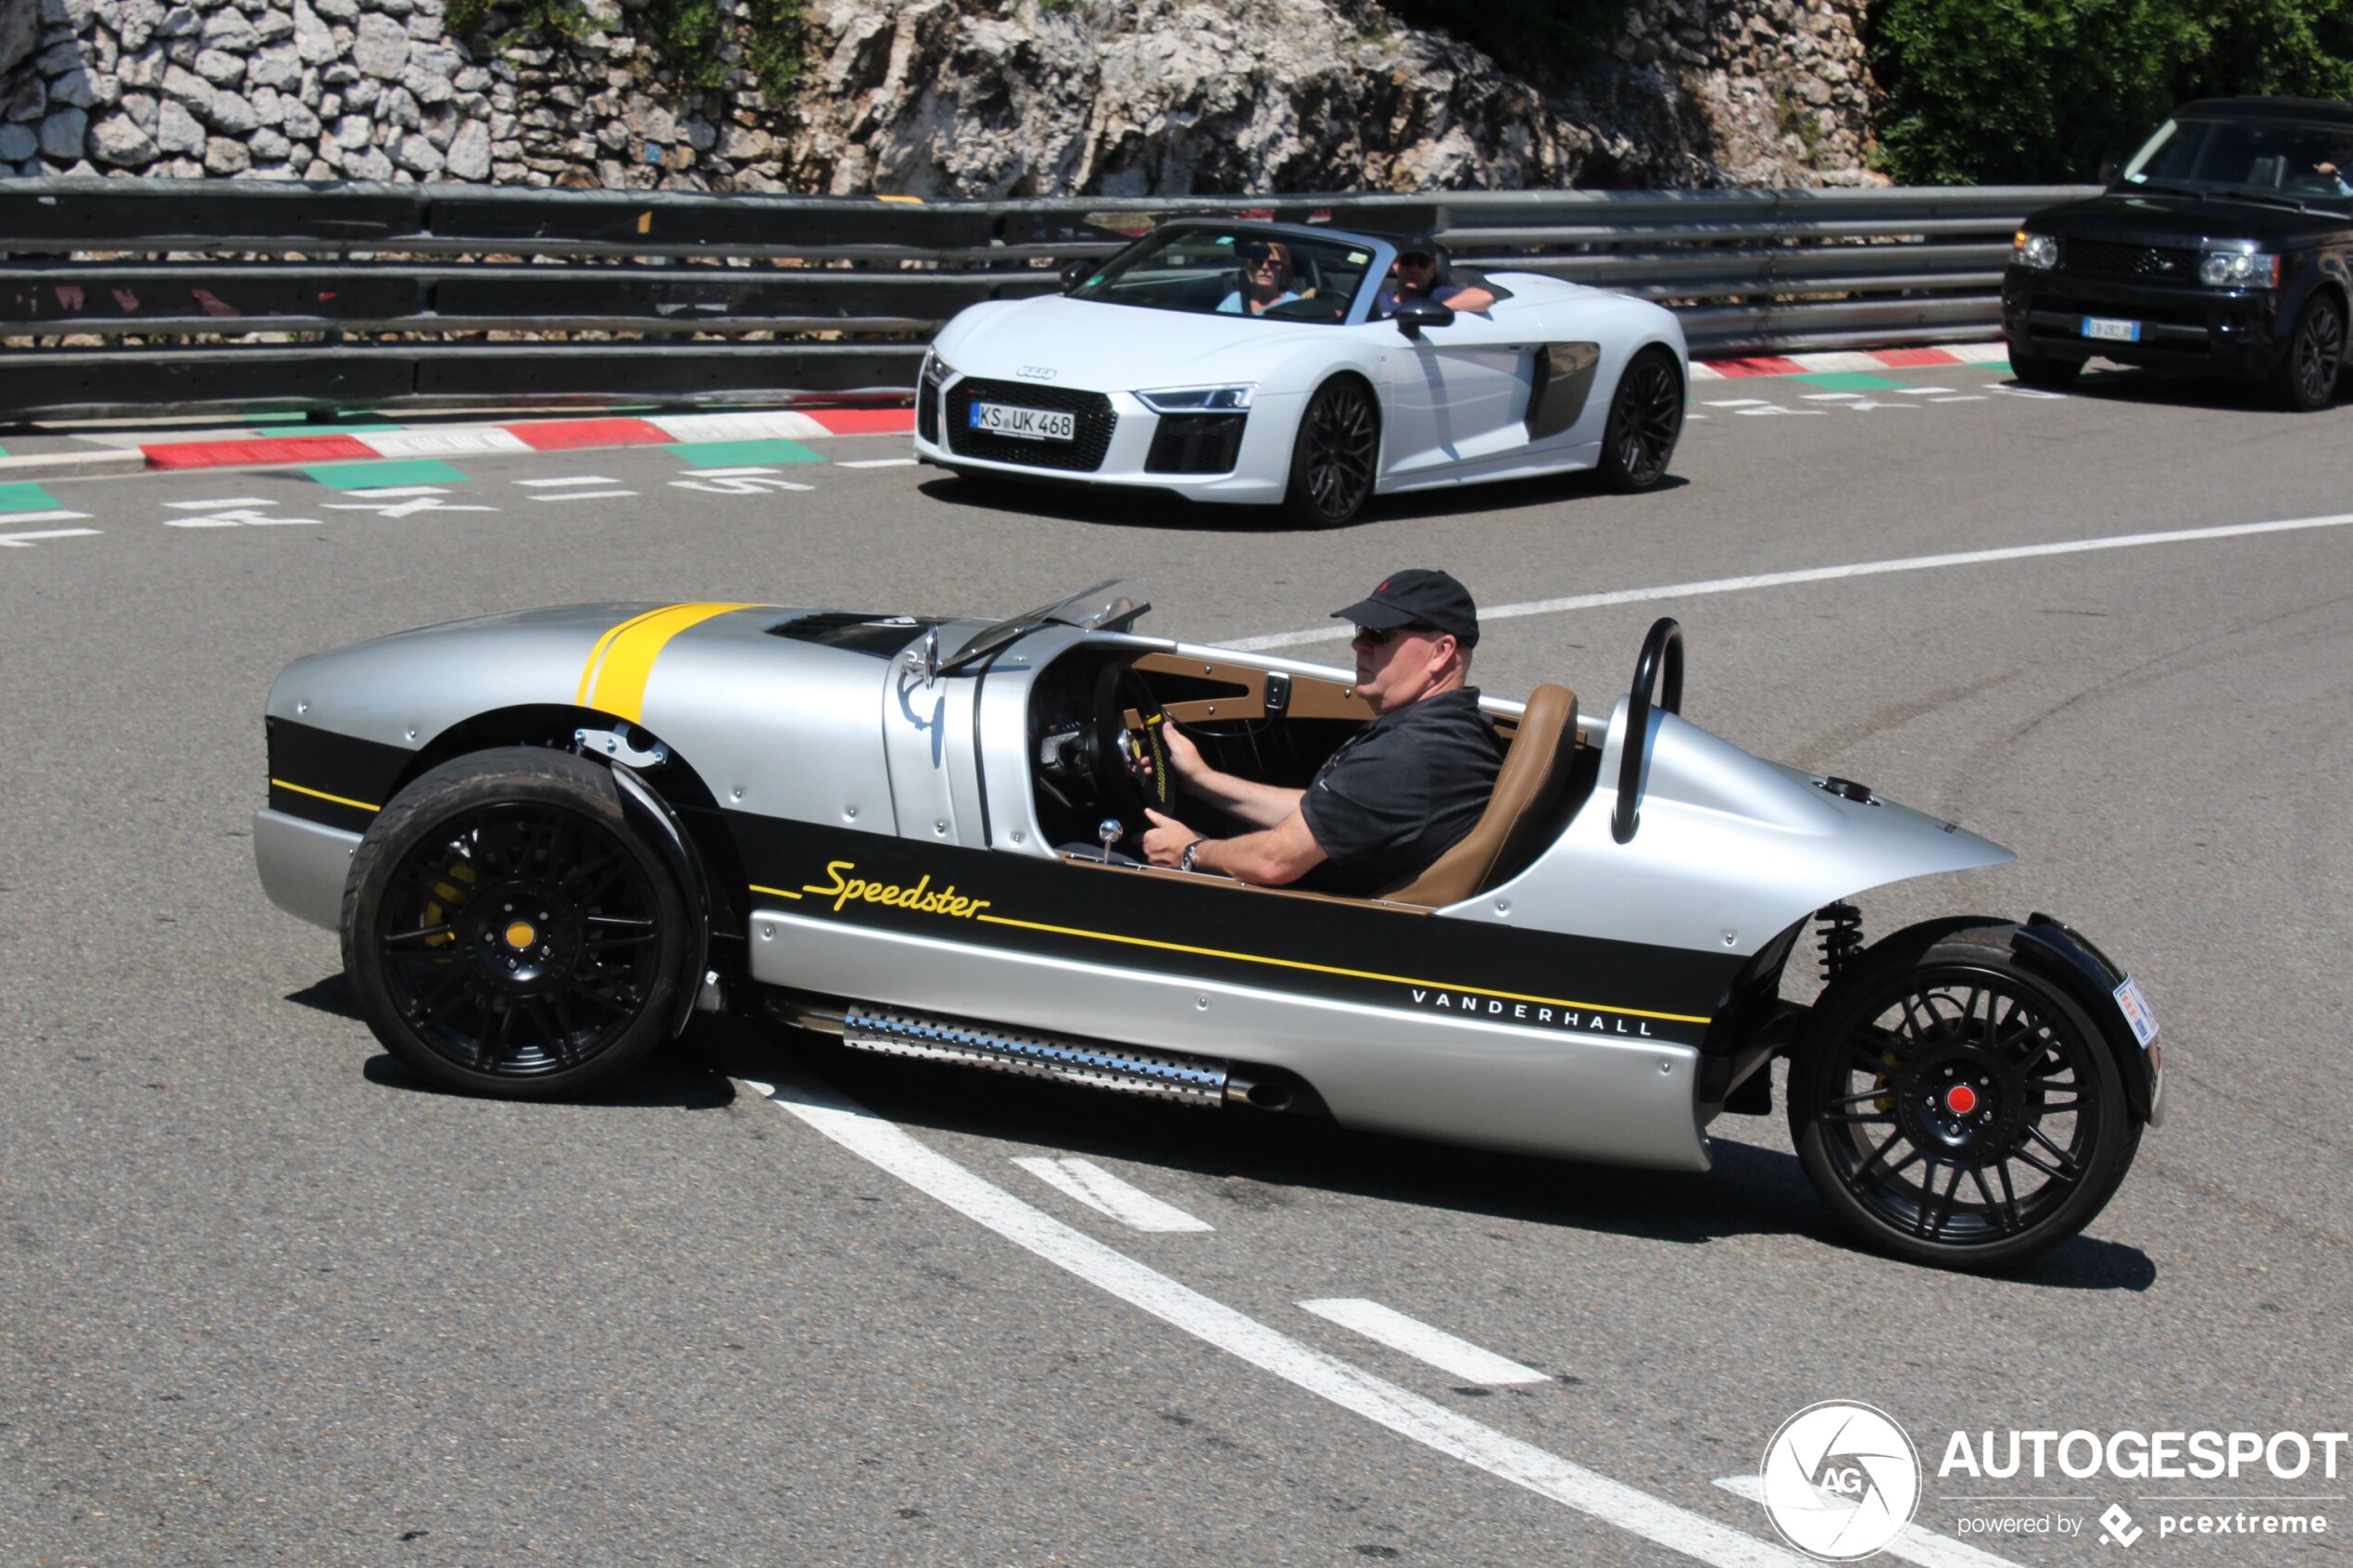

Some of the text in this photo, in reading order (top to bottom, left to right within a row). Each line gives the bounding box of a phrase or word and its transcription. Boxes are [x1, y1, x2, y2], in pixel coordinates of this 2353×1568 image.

[980, 408, 1001, 427] KS
[1013, 410, 1035, 432] UK
[1038, 414, 1071, 436] 468
[802, 860, 990, 919] Speedster
[1412, 989, 1652, 1036] VANDERHALL
